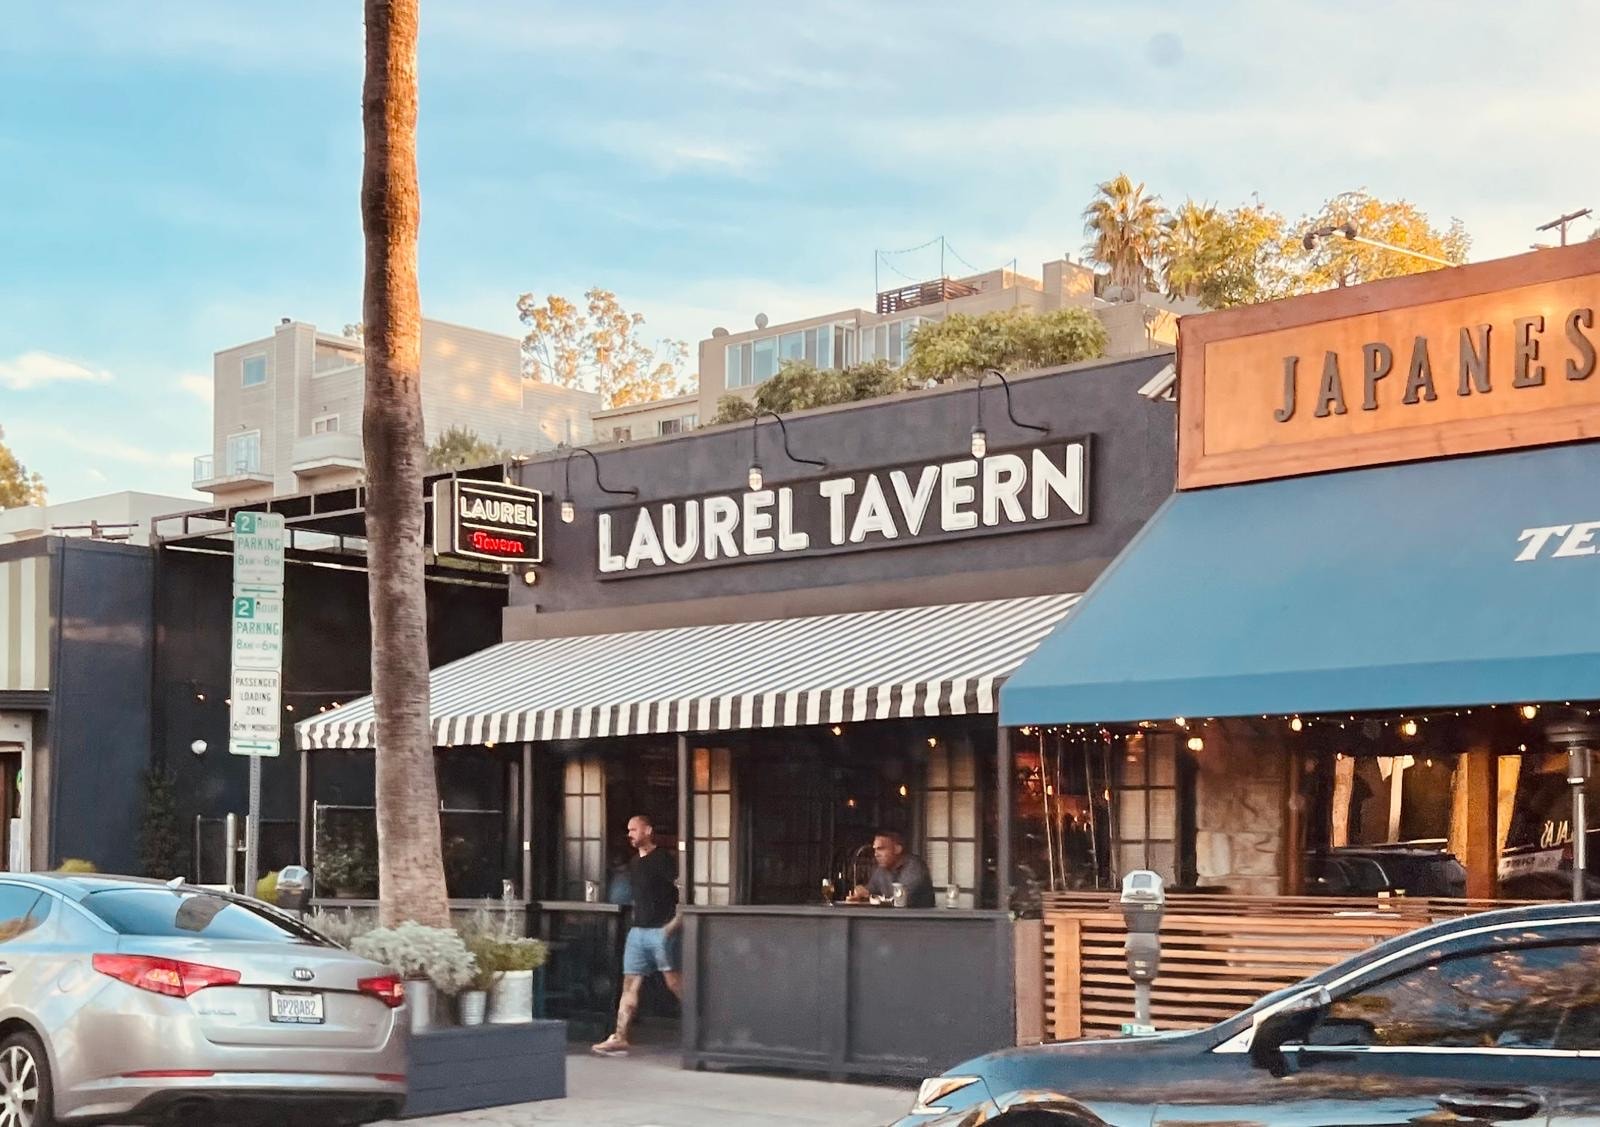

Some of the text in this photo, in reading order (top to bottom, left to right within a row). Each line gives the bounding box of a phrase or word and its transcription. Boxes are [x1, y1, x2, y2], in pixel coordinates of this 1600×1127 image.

[1274, 308, 1596, 422] JAPANES
[460, 496, 537, 527] LAUREL
[599, 443, 1084, 573] LAUREL TAVERN
[240, 516, 250, 531] 2
[237, 537, 281, 551] PARKING
[472, 531, 524, 553] Tavern
[1514, 522, 1600, 562] TE
[238, 600, 249, 616] 2
[236, 621, 279, 636] PARKING
[235, 677, 277, 688] PASSENGER
[240, 692, 272, 702] LOADING
[295, 969, 313, 979] KIA
